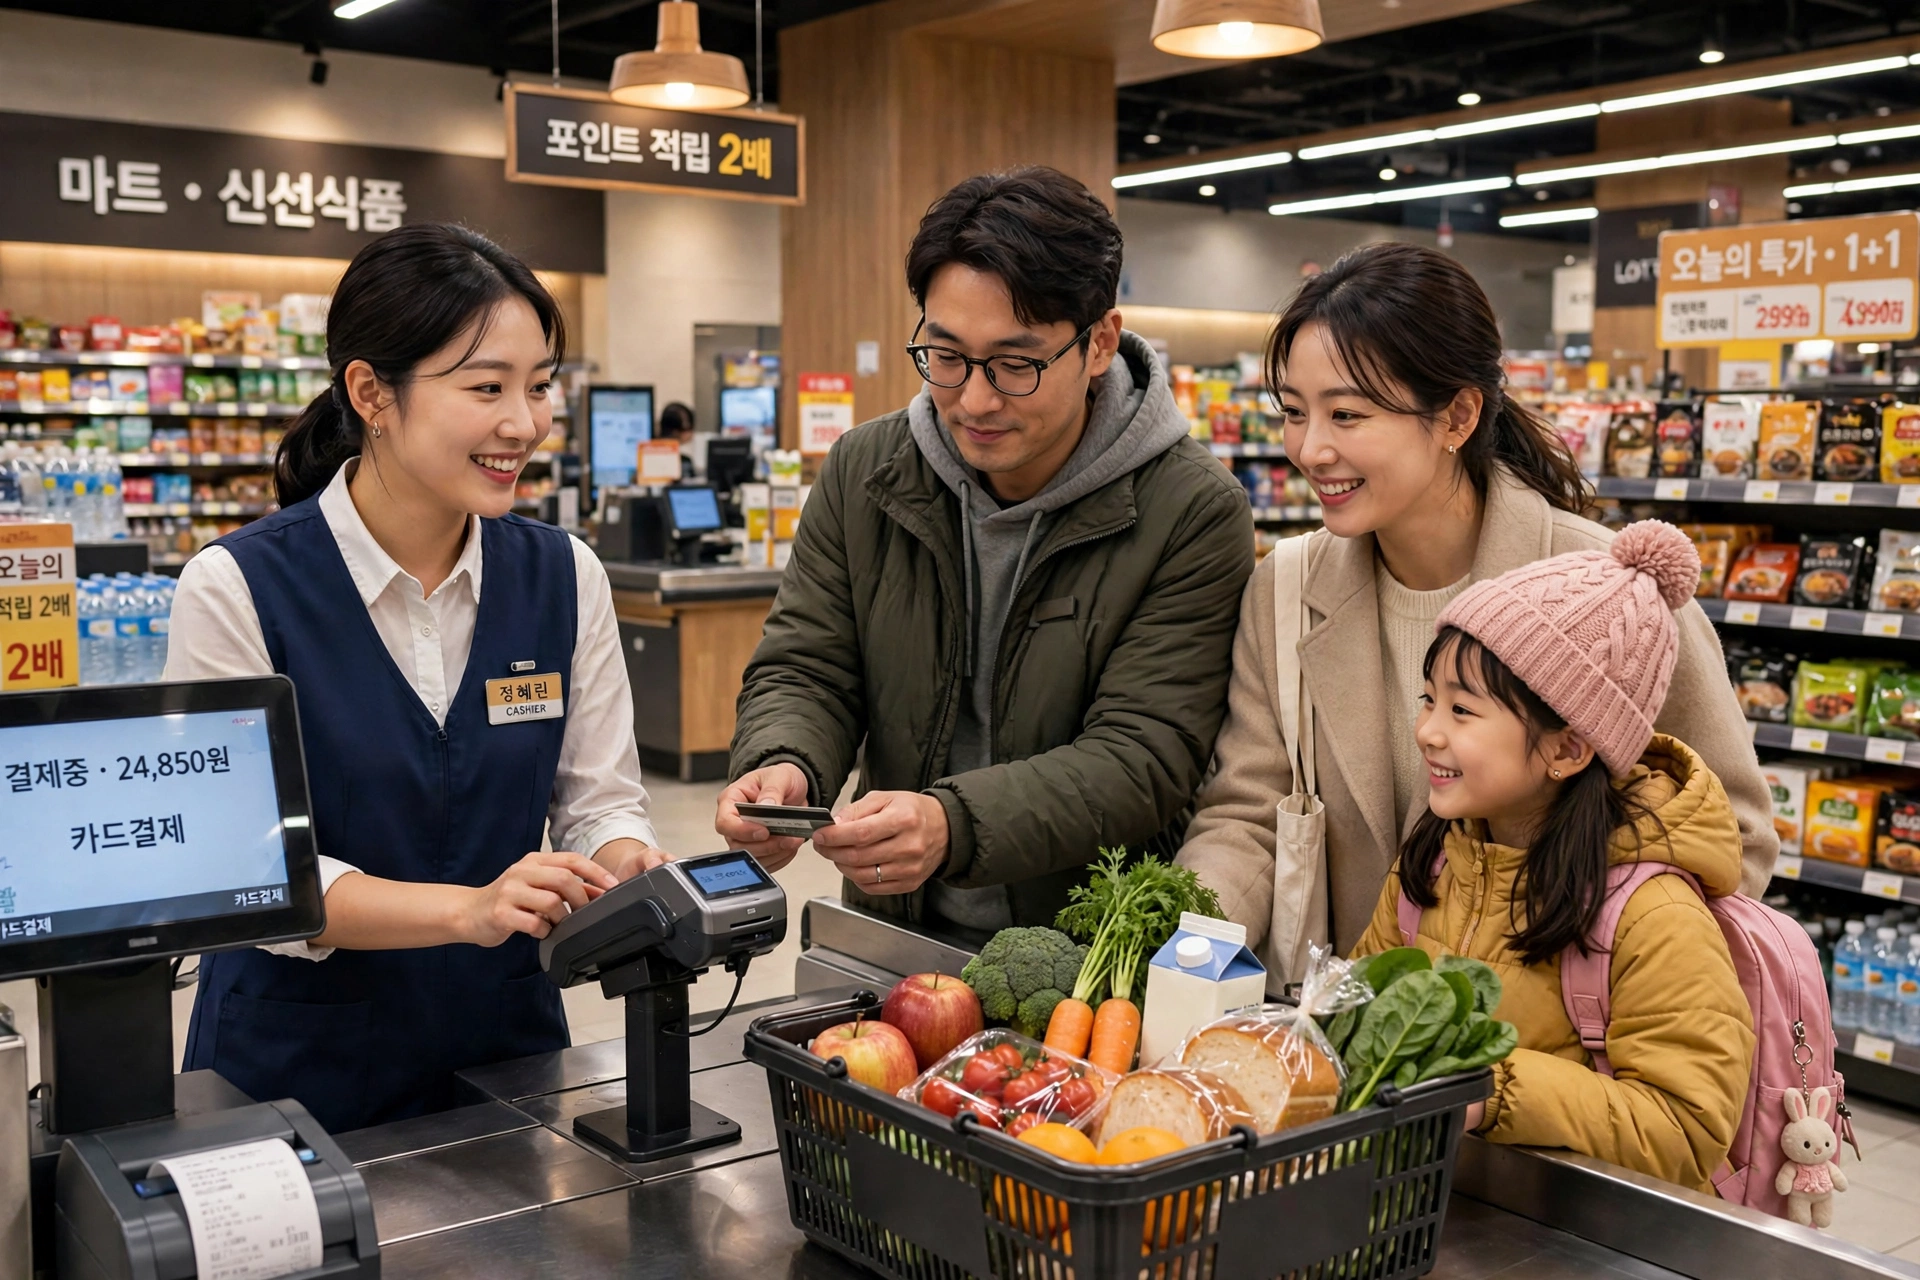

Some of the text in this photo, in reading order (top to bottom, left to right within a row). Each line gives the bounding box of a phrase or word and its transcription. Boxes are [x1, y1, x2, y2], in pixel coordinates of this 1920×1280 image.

[546, 118, 772, 180] 포인트 적립 2배
[58, 154, 168, 215] 마트
[217, 168, 407, 232] 신선식품
[1671, 241, 1751, 283] 오늘의
[1758, 235, 1817, 278] 특가
[1844, 228, 1900, 273] 1+1
[0, 553, 63, 580] 오늘의
[0, 593, 71, 621] 적립 2배
[6, 639, 64, 681] 2배
[499, 681, 548, 703] 정혜린
[506, 704, 547, 717] CASHIER
[5, 758, 89, 793] 결제중
[116, 746, 231, 782] 24,850원
[70, 813, 186, 855] 카드결제
